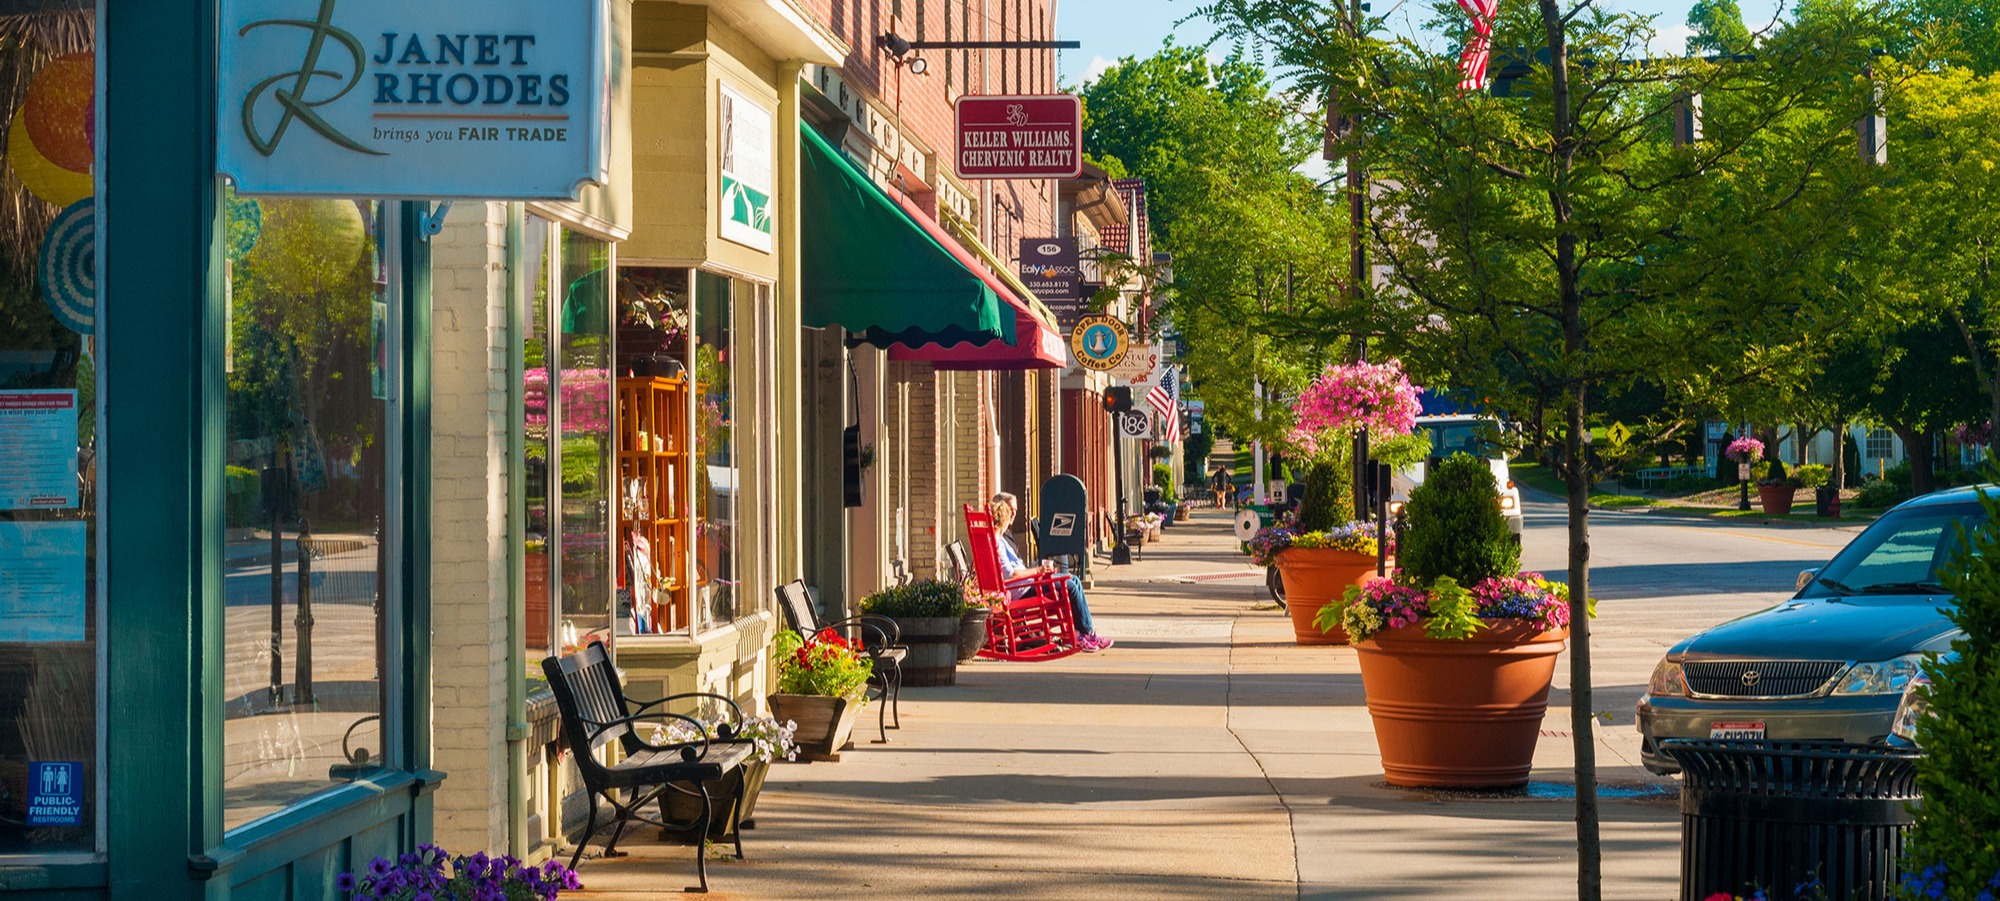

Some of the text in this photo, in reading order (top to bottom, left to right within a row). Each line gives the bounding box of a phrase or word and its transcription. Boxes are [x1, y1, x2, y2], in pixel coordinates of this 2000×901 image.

[373, 32, 536, 66] JANET
[373, 73, 570, 107] RHODES
[373, 127, 567, 143] brings you FAIR TRADE
[964, 130, 1070, 148] KELLER WILLIAMS
[962, 149, 1073, 167] CHERVENIC REALTY
[1021, 264, 1040, 276] Ealy
[1075, 316, 1125, 337] OPEN DOOR
[1076, 350, 1124, 369] Coffee Co.
[1124, 415, 1147, 434] 186
[34, 796, 76, 806] PUBLIC-
[29, 806, 80, 816] FRIENDLY
[33, 816, 76, 824] RESTROOMS
